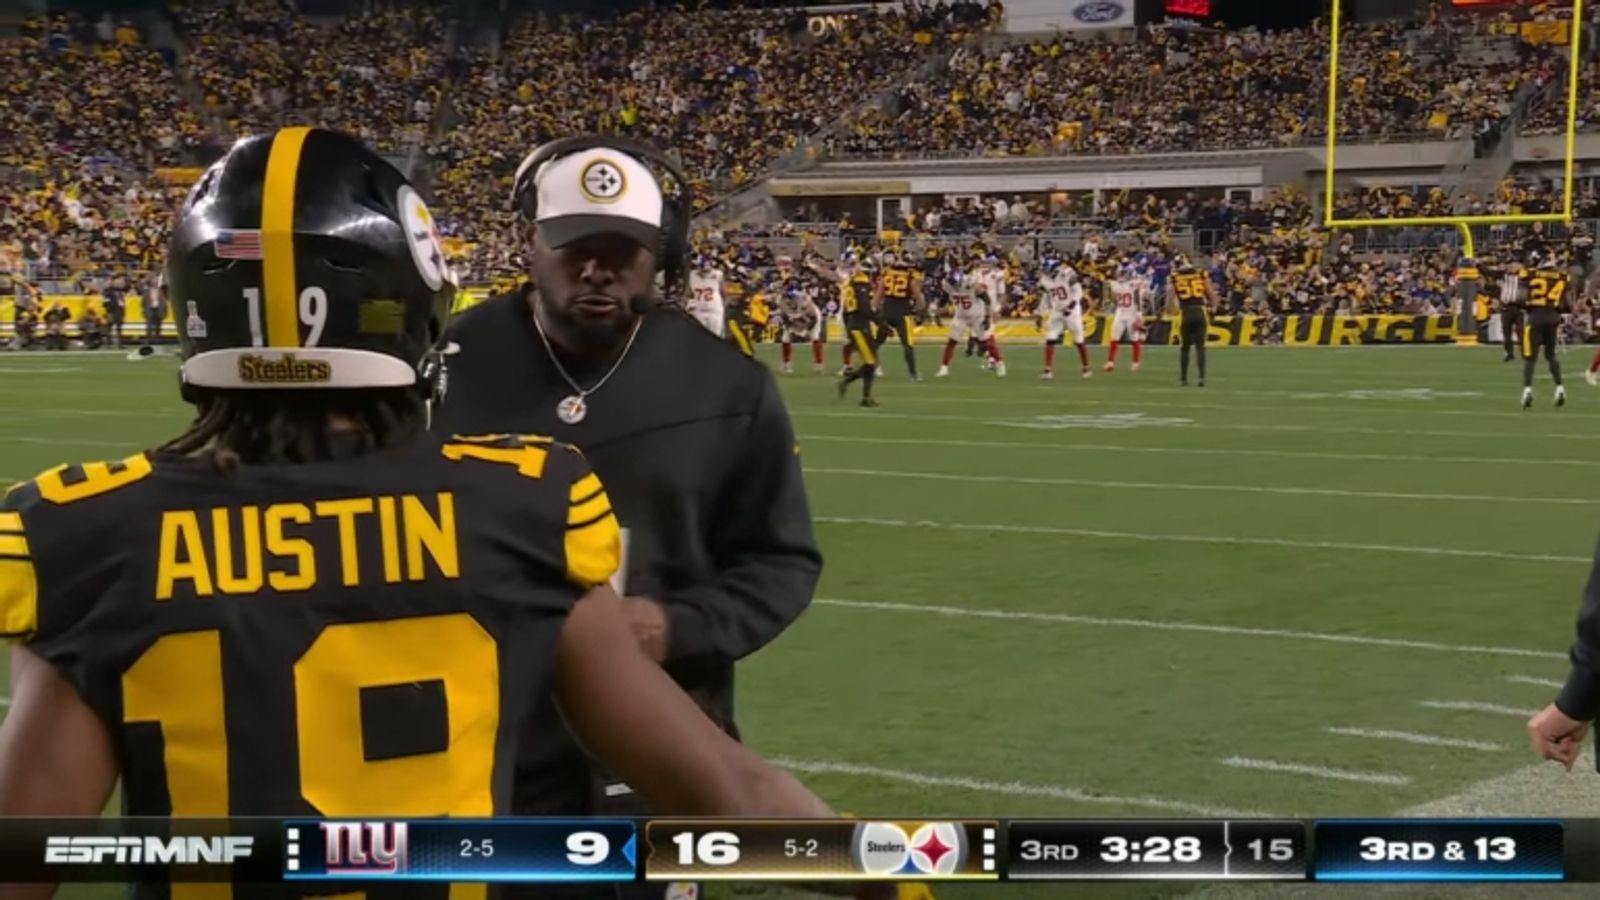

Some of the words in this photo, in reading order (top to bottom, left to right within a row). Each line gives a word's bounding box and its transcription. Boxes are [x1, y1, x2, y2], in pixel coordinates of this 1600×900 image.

[694, 287, 714, 302] 72
[883, 275, 908, 298] 92
[1176, 279, 1205, 299] 56
[1528, 278, 1566, 307] 24
[1053, 313, 1461, 347] PITSURGH
[238, 353, 332, 384] Steelers
[154, 491, 461, 601] AUSTIN
[121, 612, 500, 818] 19
